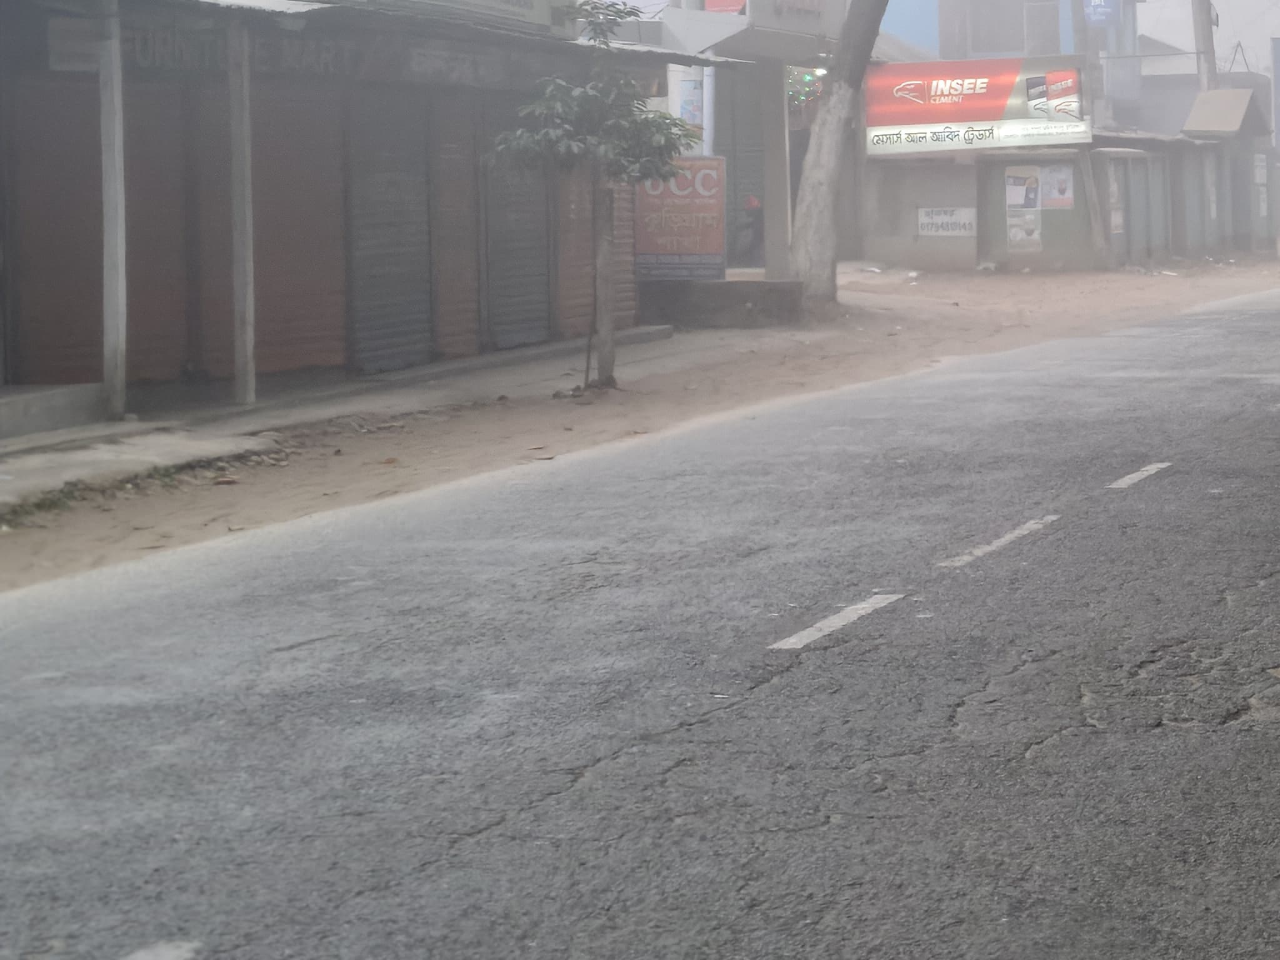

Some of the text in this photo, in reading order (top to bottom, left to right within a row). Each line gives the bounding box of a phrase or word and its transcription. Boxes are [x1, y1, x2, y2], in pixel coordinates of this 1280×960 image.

[930, 78, 989, 96] INSEE
[930, 95, 964, 104] CEMENT
[871, 129, 902, 146] মেসার্স
[904, 131, 927, 144] আল
[963, 125, 995, 145] ট্রেডার্স
